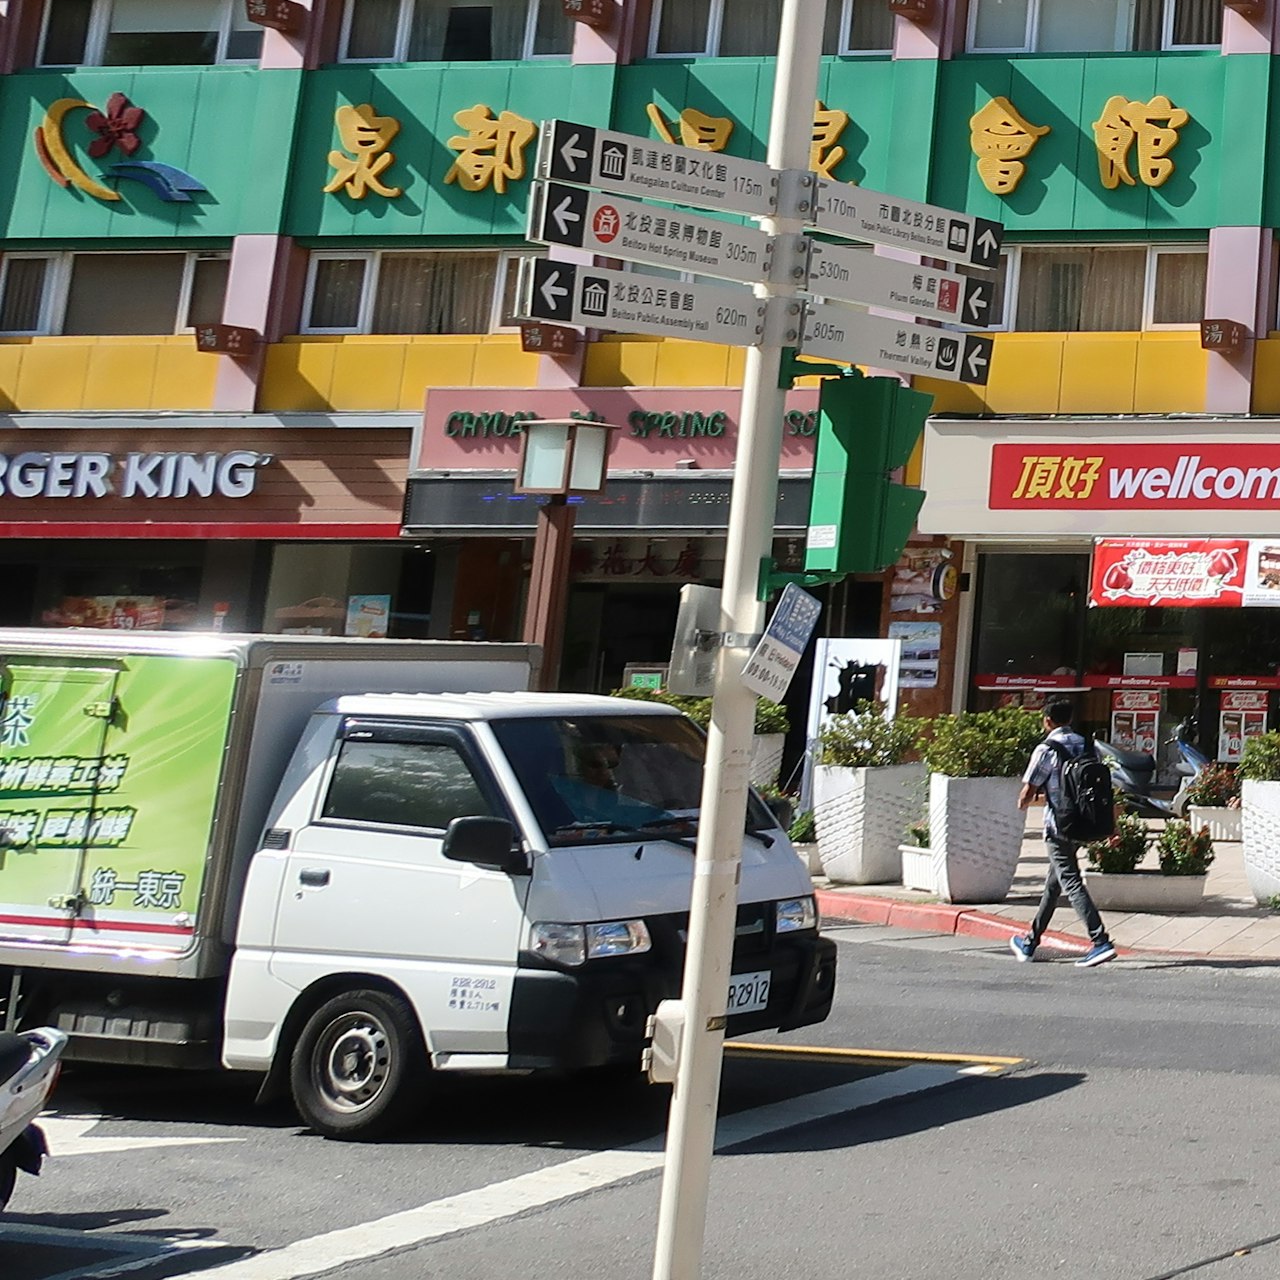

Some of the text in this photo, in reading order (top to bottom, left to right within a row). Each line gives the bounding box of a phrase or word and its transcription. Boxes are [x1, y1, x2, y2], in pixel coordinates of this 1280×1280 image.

[733, 176, 763, 197] 175m
[826, 198, 857, 219] 170m
[622, 236, 719, 265] Beitou Hot Spring Museum
[725, 242, 758, 264] 305m
[819, 261, 850, 281] 530m
[614, 282, 748, 327] 北投公民會館 620m
[890, 290, 935, 309] Plum Garden
[612, 308, 710, 331] Beitou Public Assembly Hall
[813, 322, 937, 352] 805m 地熱谷
[879, 349, 933, 368] Thermal Valley
[628, 409, 726, 438] SPRING
[122, 451, 262, 499] KING
[1012, 456, 1104, 501] 頂好
[89, 867, 186, 908] 統一東京
